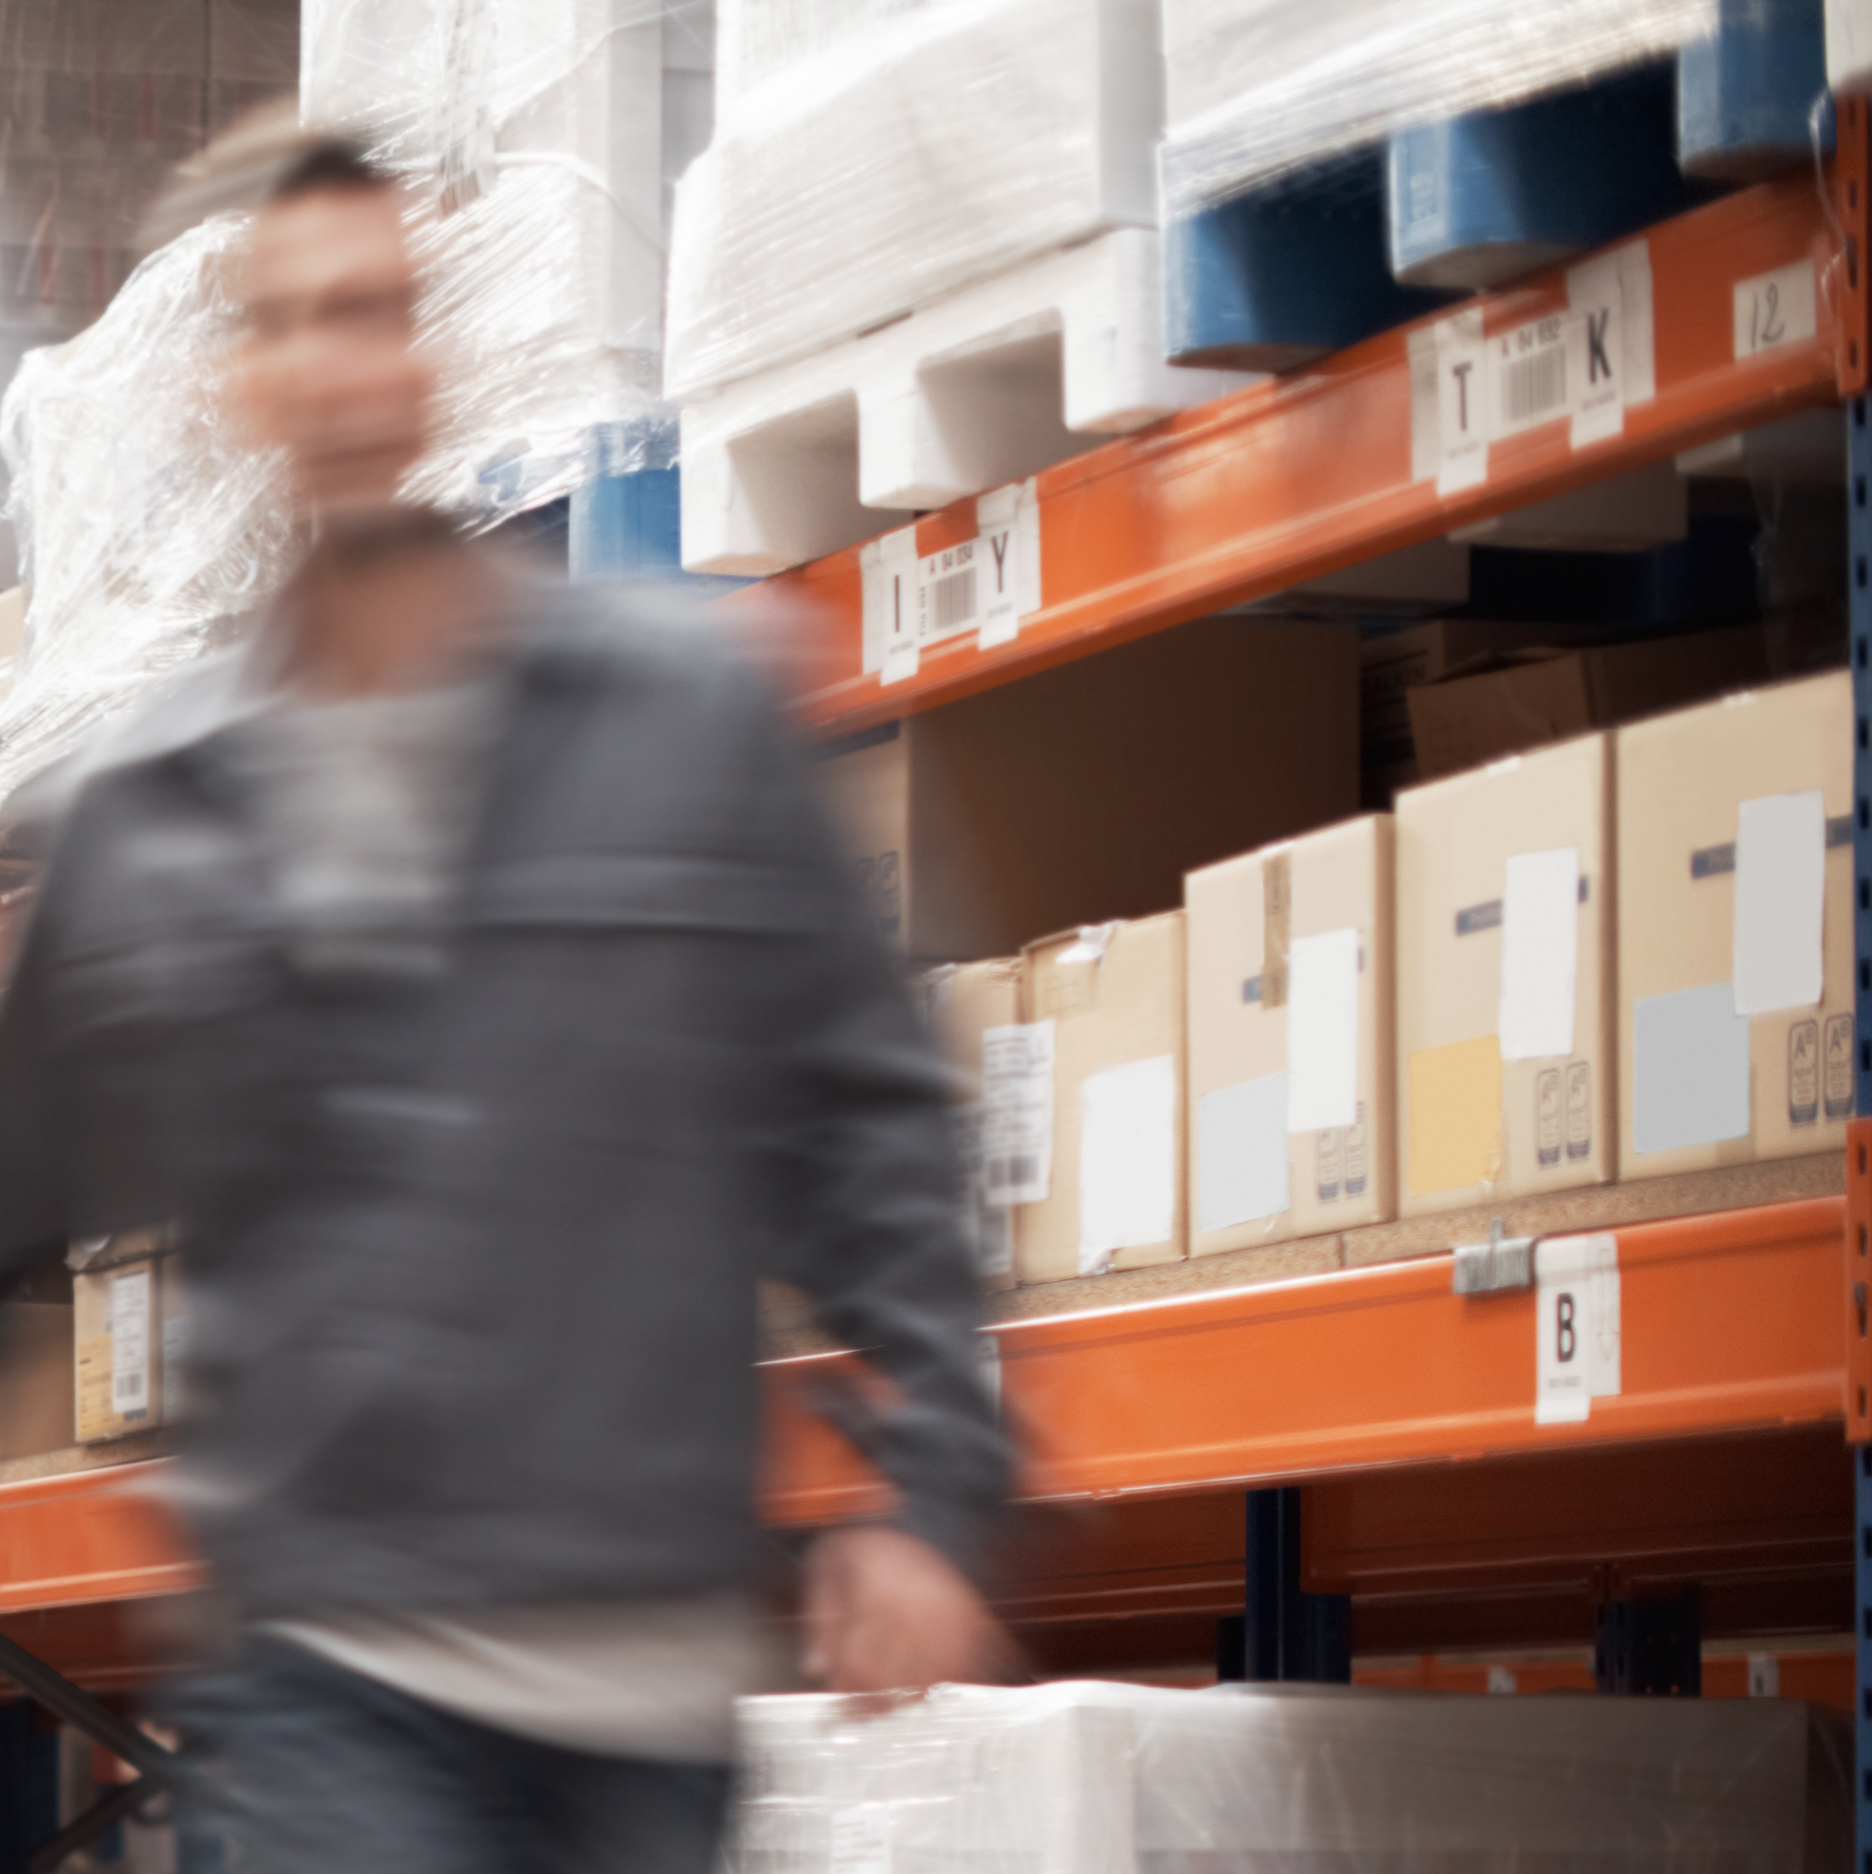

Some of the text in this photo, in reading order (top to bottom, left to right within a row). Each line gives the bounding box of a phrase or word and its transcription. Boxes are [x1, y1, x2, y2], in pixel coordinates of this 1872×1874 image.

[1588, 307, 1611, 384] K
[1751, 282, 1786, 351] 12
[1453, 361, 1472, 431] T
[991, 530, 1009, 593] Y
[894, 574, 900, 633] I
[1556, 1292, 1576, 1363] B
